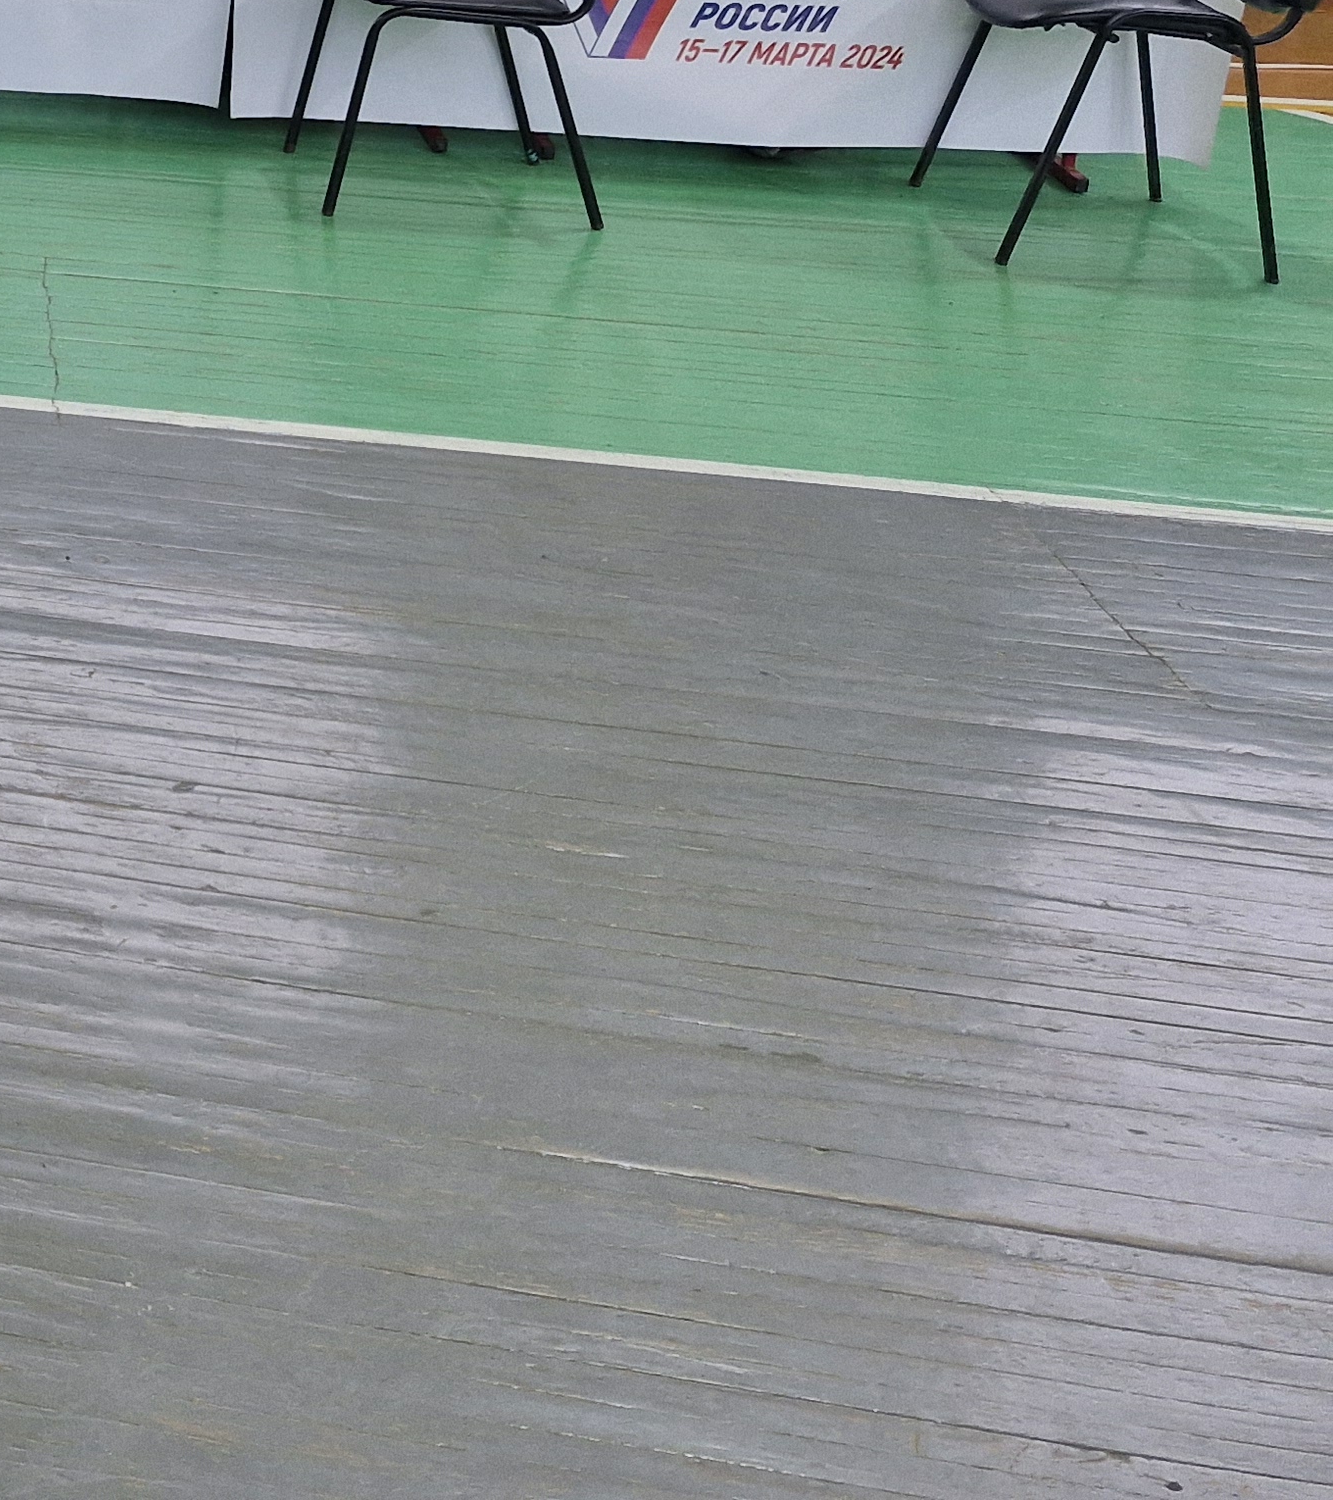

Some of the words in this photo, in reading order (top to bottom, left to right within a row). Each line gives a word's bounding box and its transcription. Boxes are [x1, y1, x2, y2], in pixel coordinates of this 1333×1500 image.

[690, 2, 839, 33] РОССИИ
[747, 41, 837, 68] МАРТА
[839, 45, 904, 70] 2024
